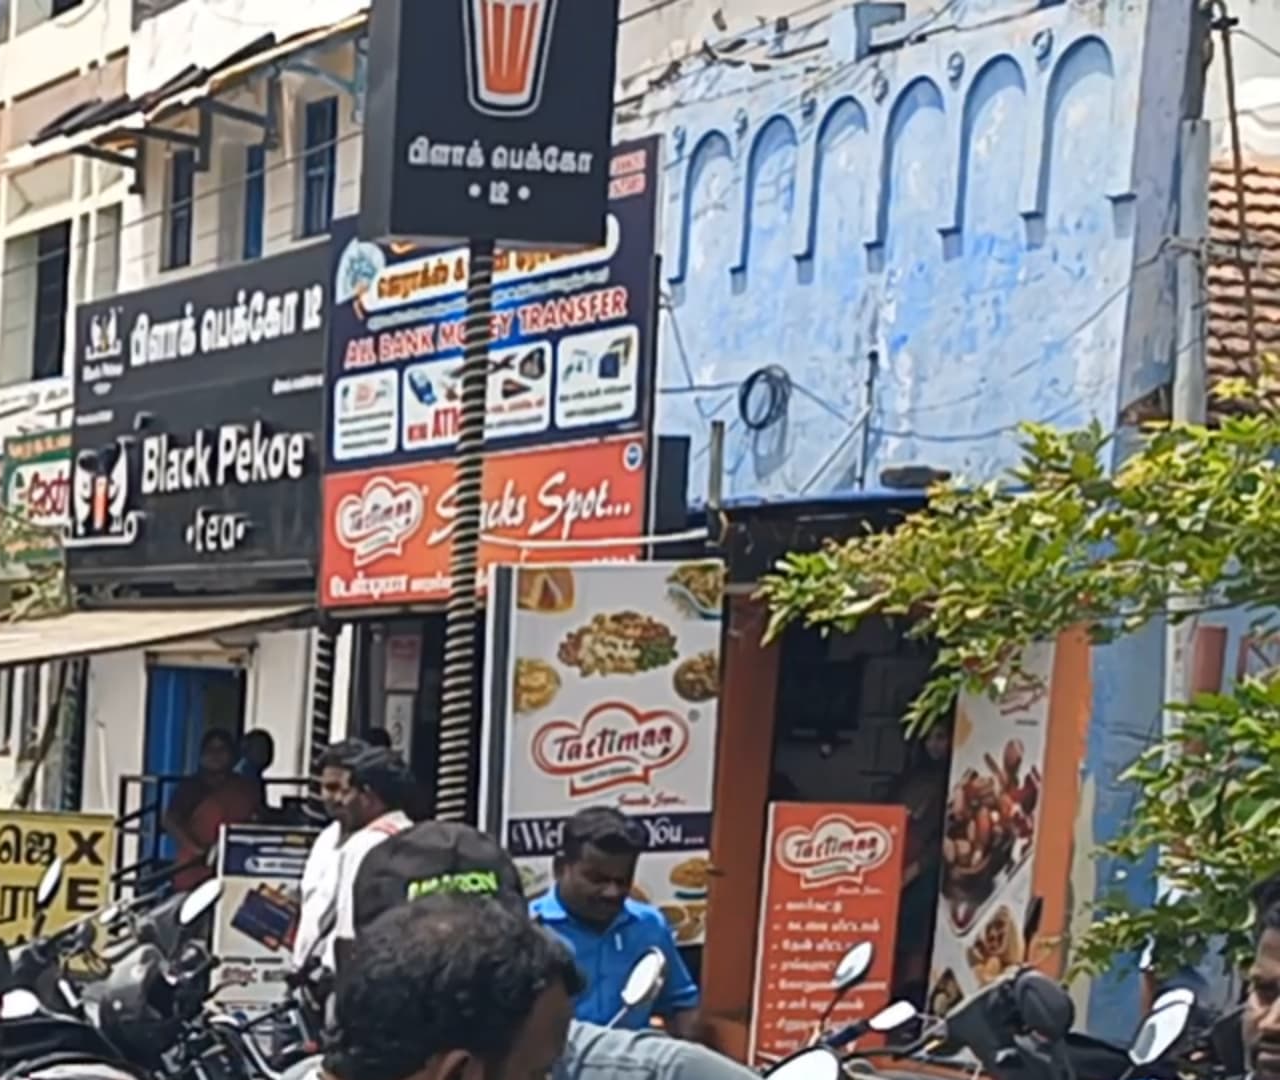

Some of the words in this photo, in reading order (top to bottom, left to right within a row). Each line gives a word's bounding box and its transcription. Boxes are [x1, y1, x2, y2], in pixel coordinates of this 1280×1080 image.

[344, 338, 376, 369] ALL
[378, 326, 434, 361] BANK
[439, 311, 513, 347] MOEY
[519, 286, 628, 329] TRANSFER
[142, 429, 211, 494] Black
[217, 420, 305, 486] Pekoe
